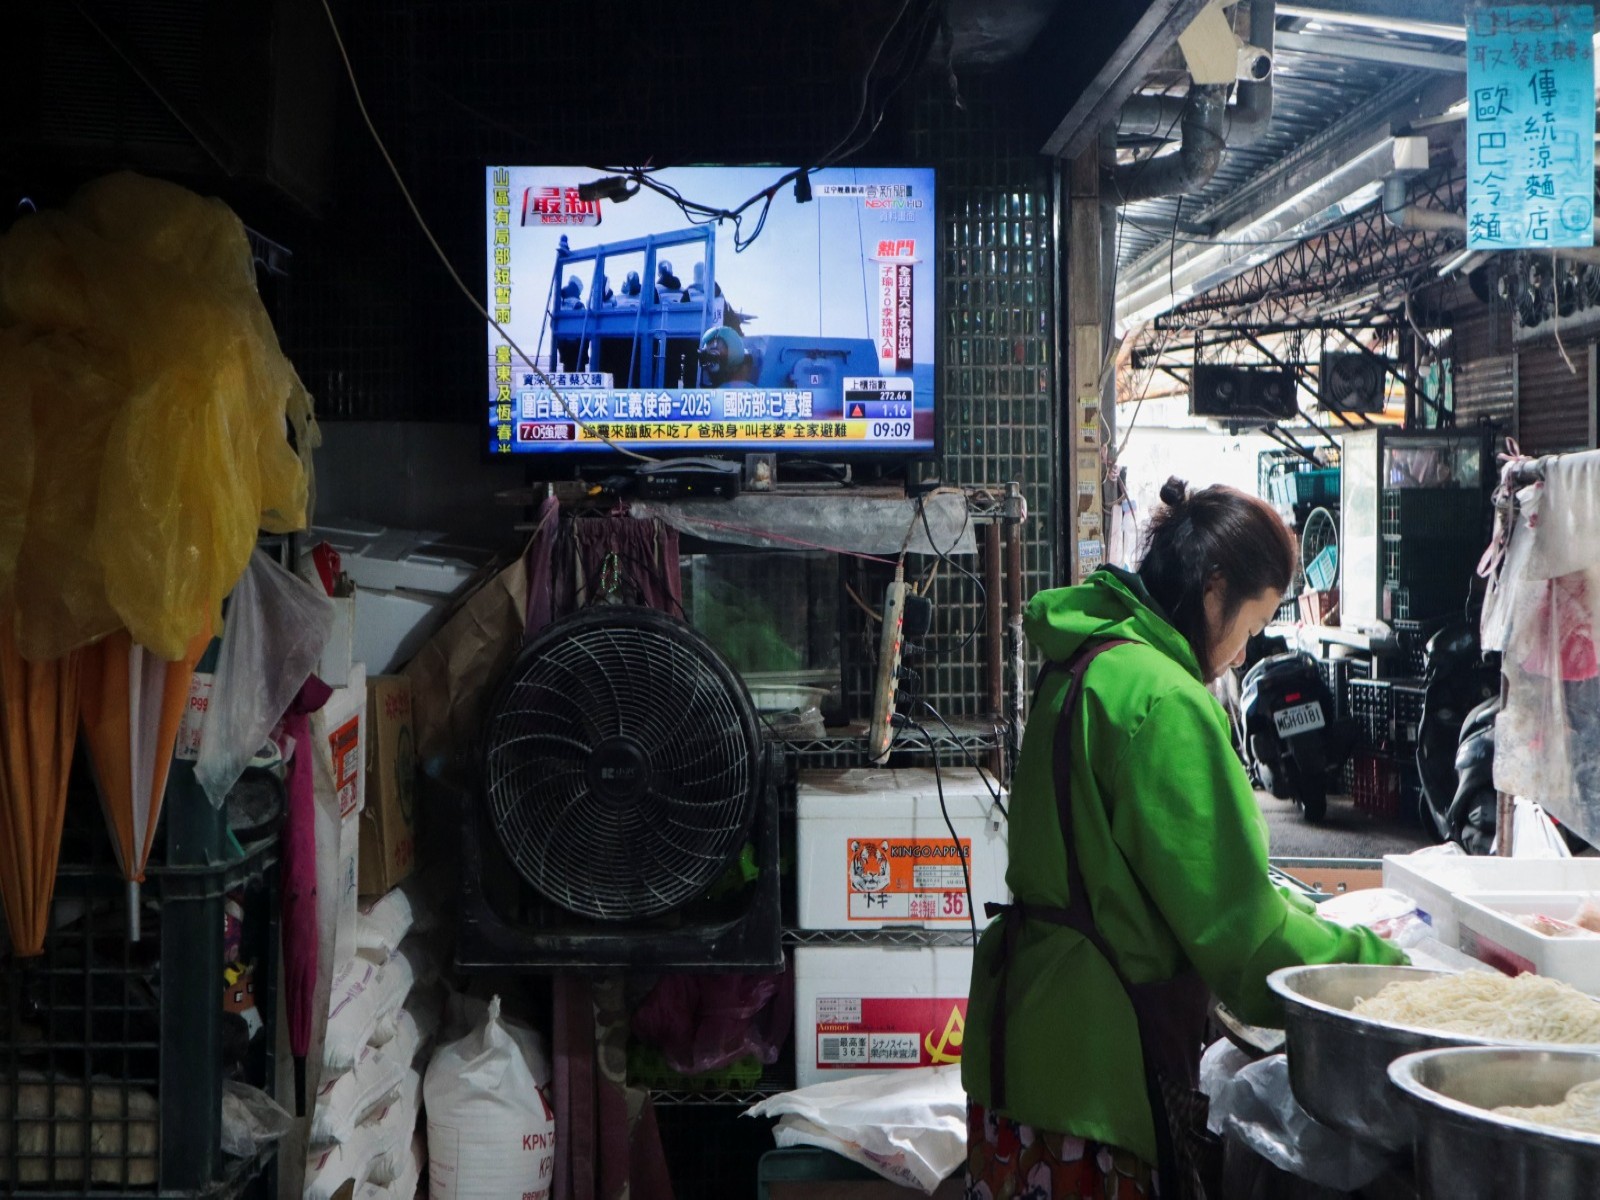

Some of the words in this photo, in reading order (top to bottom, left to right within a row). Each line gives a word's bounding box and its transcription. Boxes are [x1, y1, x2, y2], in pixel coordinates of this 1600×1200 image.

[1470, 83, 1513, 243] 歐巴冷麵
[1523, 69, 1558, 241] 傳統涼麵店
[532, 187, 594, 215] 最新
[877, 240, 915, 257] 熱門
[523, 373, 566, 386] 資深記者
[850, 380, 887, 390] 上櫃指數
[880, 391, 907, 401] 272.66
[882, 404, 907, 416] 1.16
[873, 422, 911, 437] 09:09
[867, 892, 888, 909] トキ
[942, 892, 963, 915] 36
[818, 1023, 849, 1031] Aomori
[872, 1039, 914, 1049] シナノスイート
[522, 1133, 547, 1151] KPN
